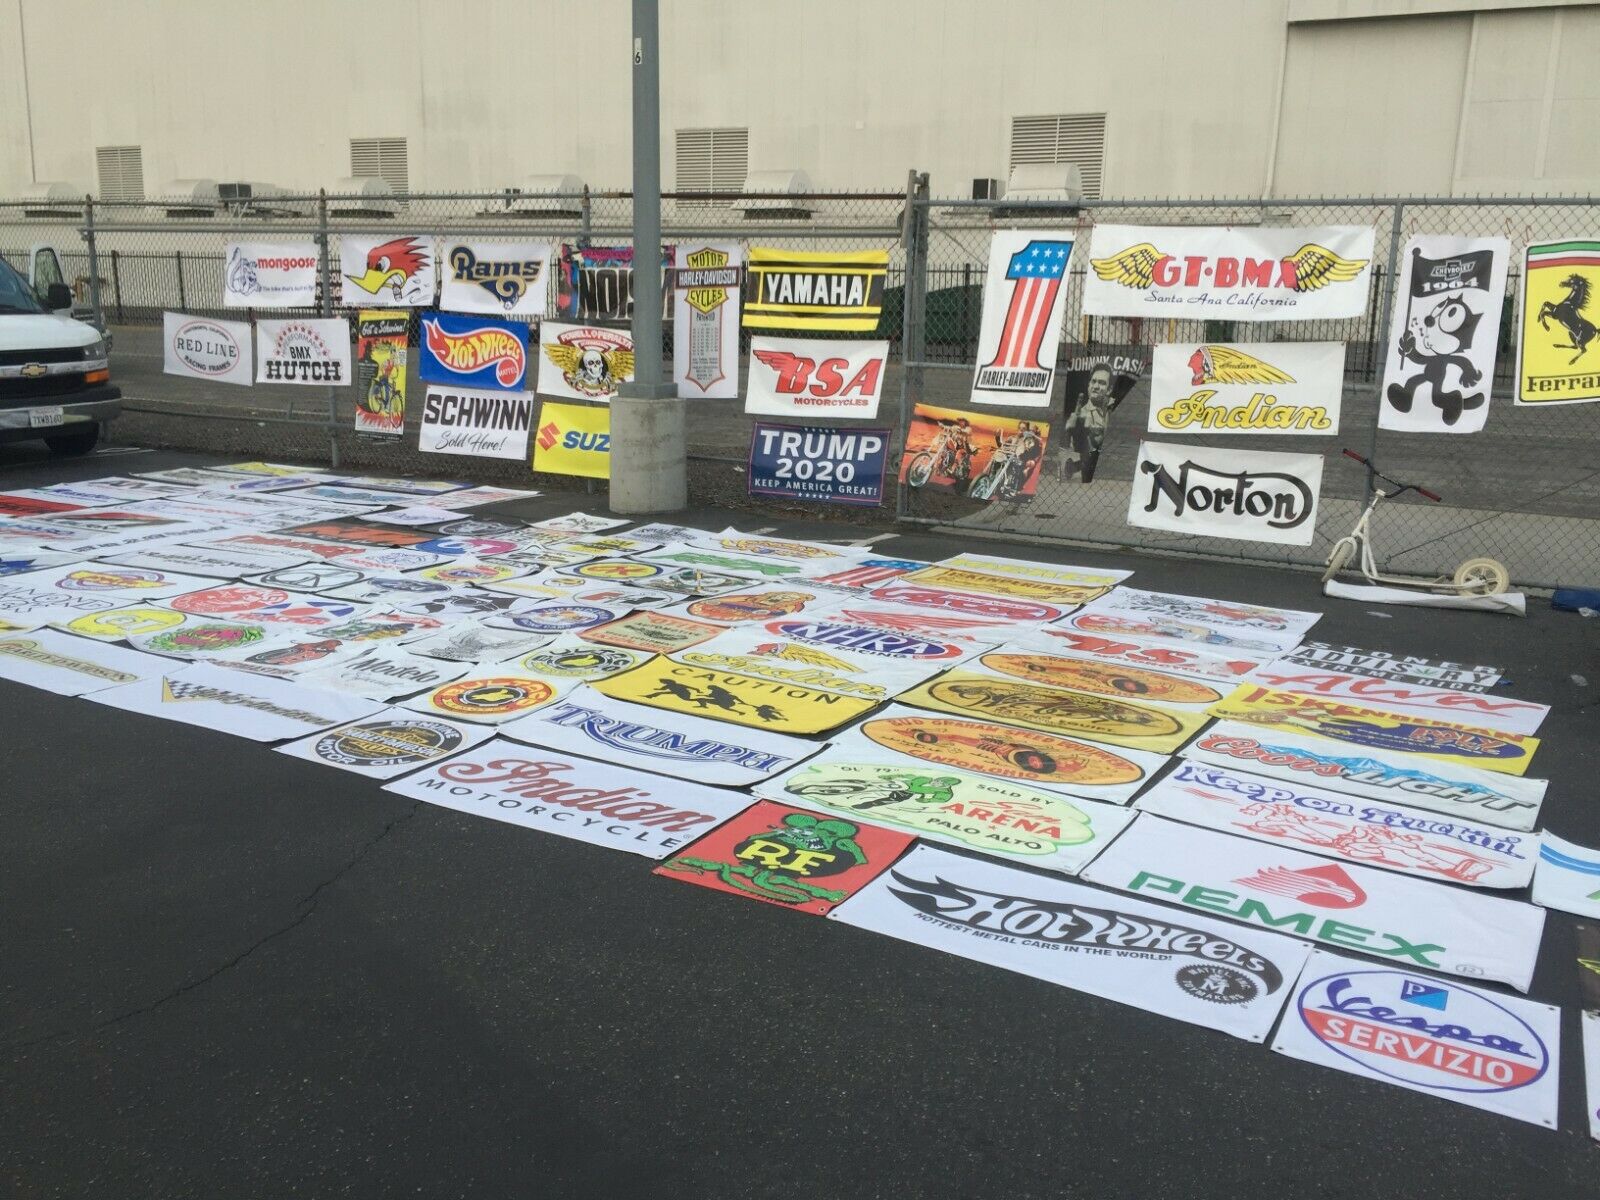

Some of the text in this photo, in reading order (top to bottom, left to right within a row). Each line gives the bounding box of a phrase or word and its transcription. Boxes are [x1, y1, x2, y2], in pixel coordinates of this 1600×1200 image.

[257, 257, 316, 272] mongoose
[452, 247, 545, 284] Rams
[691, 251, 724, 267] MOTOR
[1434, 264, 1471, 275] CHEVROLET
[678, 269, 737, 286] HARLEY-DAVIDSON
[766, 273, 863, 305] YAMAHA
[690, 289, 723, 307] CYCLES
[986, 239, 1075, 370] 1
[1144, 290, 1298, 313] Santa Ana California
[177, 337, 237, 358] RED LINE
[289, 346, 312, 360] BMX
[266, 360, 342, 381] HUTCH
[775, 357, 883, 397] BSA
[980, 367, 1047, 388] HARLEY-DAVIDSON
[1113, 355, 1147, 376] CASH
[424, 393, 531, 431] SCHWINN
[793, 397, 869, 407] MOTORCYCLES
[1157, 389, 1332, 430] Indian
[435, 430, 505, 452] Sold Here!
[759, 429, 882, 462] TRUMP
[774, 458, 856, 483] 2020
[754, 477, 878, 496] KEEP AMERICA GREAT!
[1140, 459, 1314, 529] Norton
[790, 623, 931, 655] NHRA
[835, 646, 908, 659] RACING
[346, 656, 440, 684] Modelo
[1309, 641, 1498, 675] STONER
[670, 666, 843, 705] CAUTION
[1282, 655, 1487, 694] EXTREME HIGH
[390, 720, 460, 739] GENUINE
[542, 702, 793, 772] TRIUMPH
[931, 719, 1001, 732] GRAHAM
[1003, 729, 1054, 744] SPEED
[318, 738, 412, 766] MOTOR OIL
[1196, 734, 1346, 777] Coors
[1341, 769, 1538, 812] LIGHT
[437, 759, 717, 833] Indian
[975, 783, 1055, 806] SOLD BY
[416, 778, 683, 849] MOTORCYCLE
[938, 802, 1062, 839] ARENA
[926, 817, 1043, 851] PALO ALTO
[1127, 870, 1448, 969] PEMEX
[913, 911, 1173, 962] HOTTEST METAL CARS IN THE WORLD!
[1405, 981, 1426, 996] P
[1316, 977, 1537, 1060] Vespa
[1322, 1018, 1514, 1084] SERVIZIO
